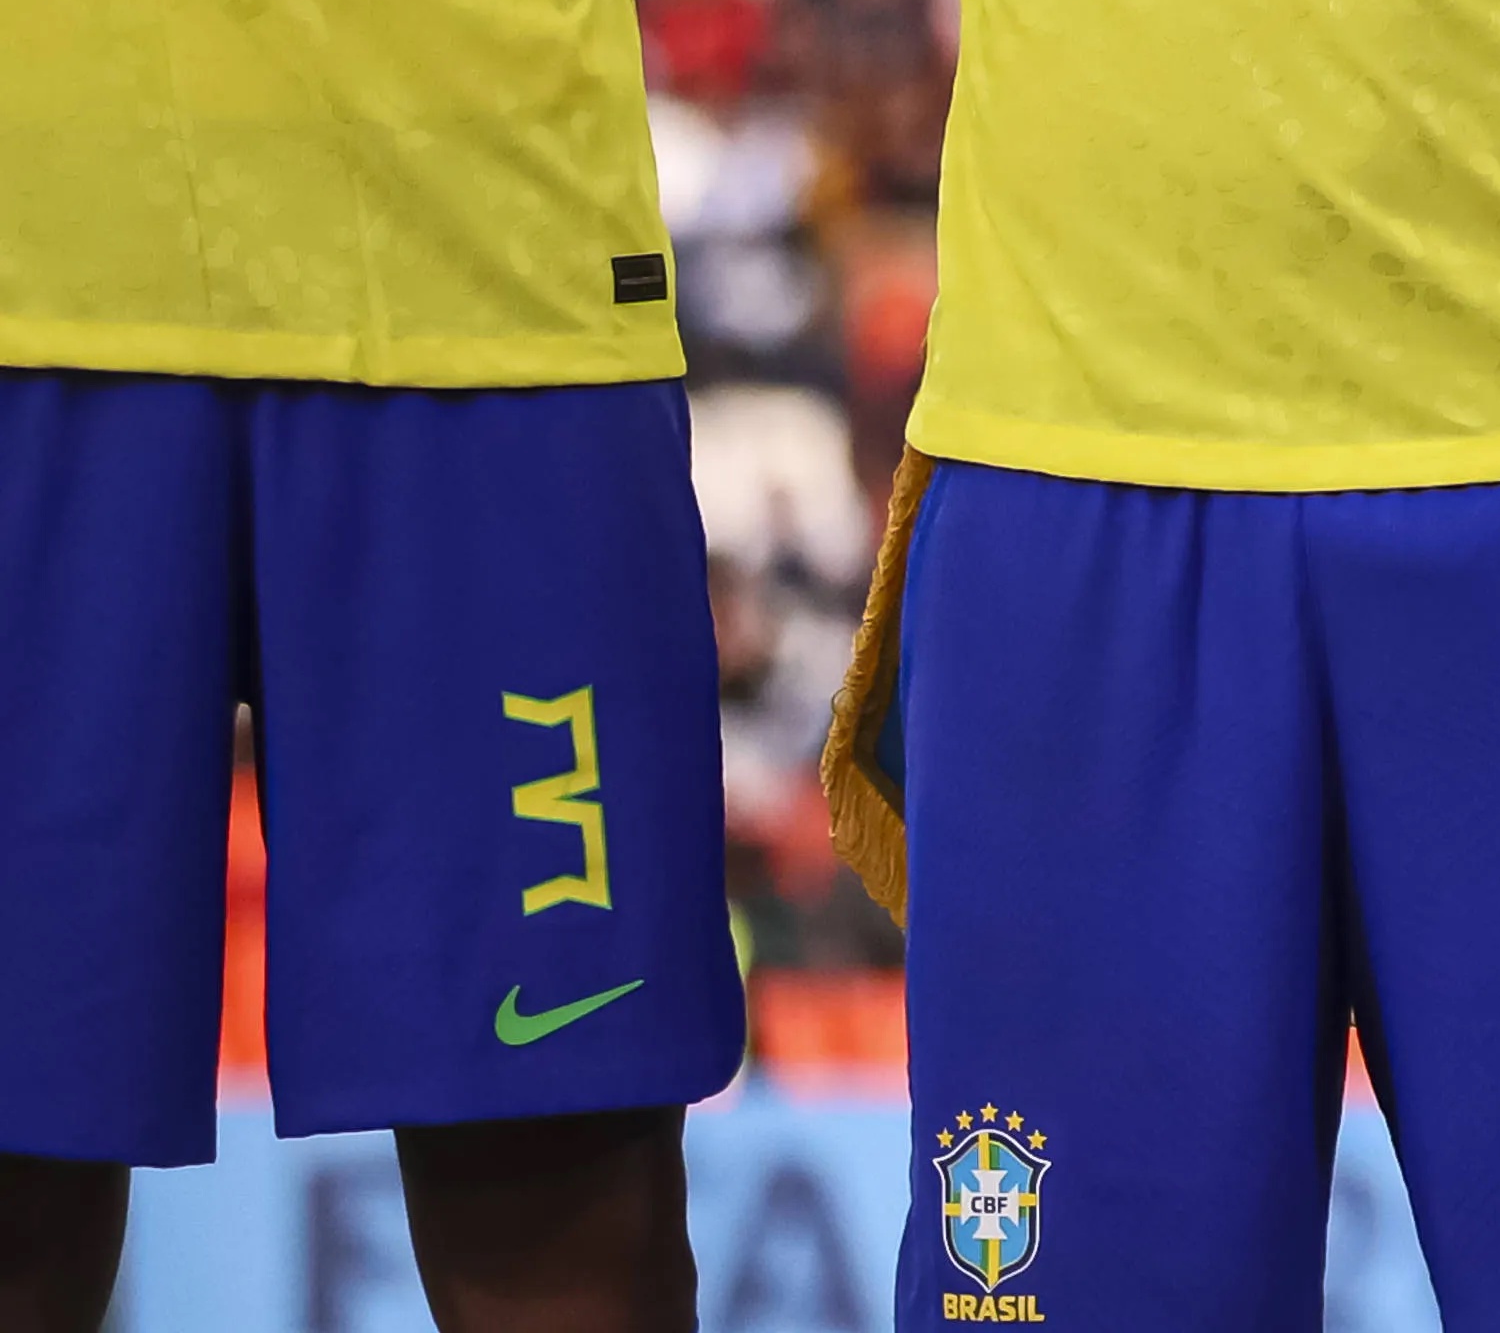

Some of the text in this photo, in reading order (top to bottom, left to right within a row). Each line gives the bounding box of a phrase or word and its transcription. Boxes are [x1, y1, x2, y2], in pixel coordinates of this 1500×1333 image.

[502, 684, 612, 917] 3
[970, 1195, 1008, 1215] CBF
[943, 1292, 1046, 1323] BRASIL
